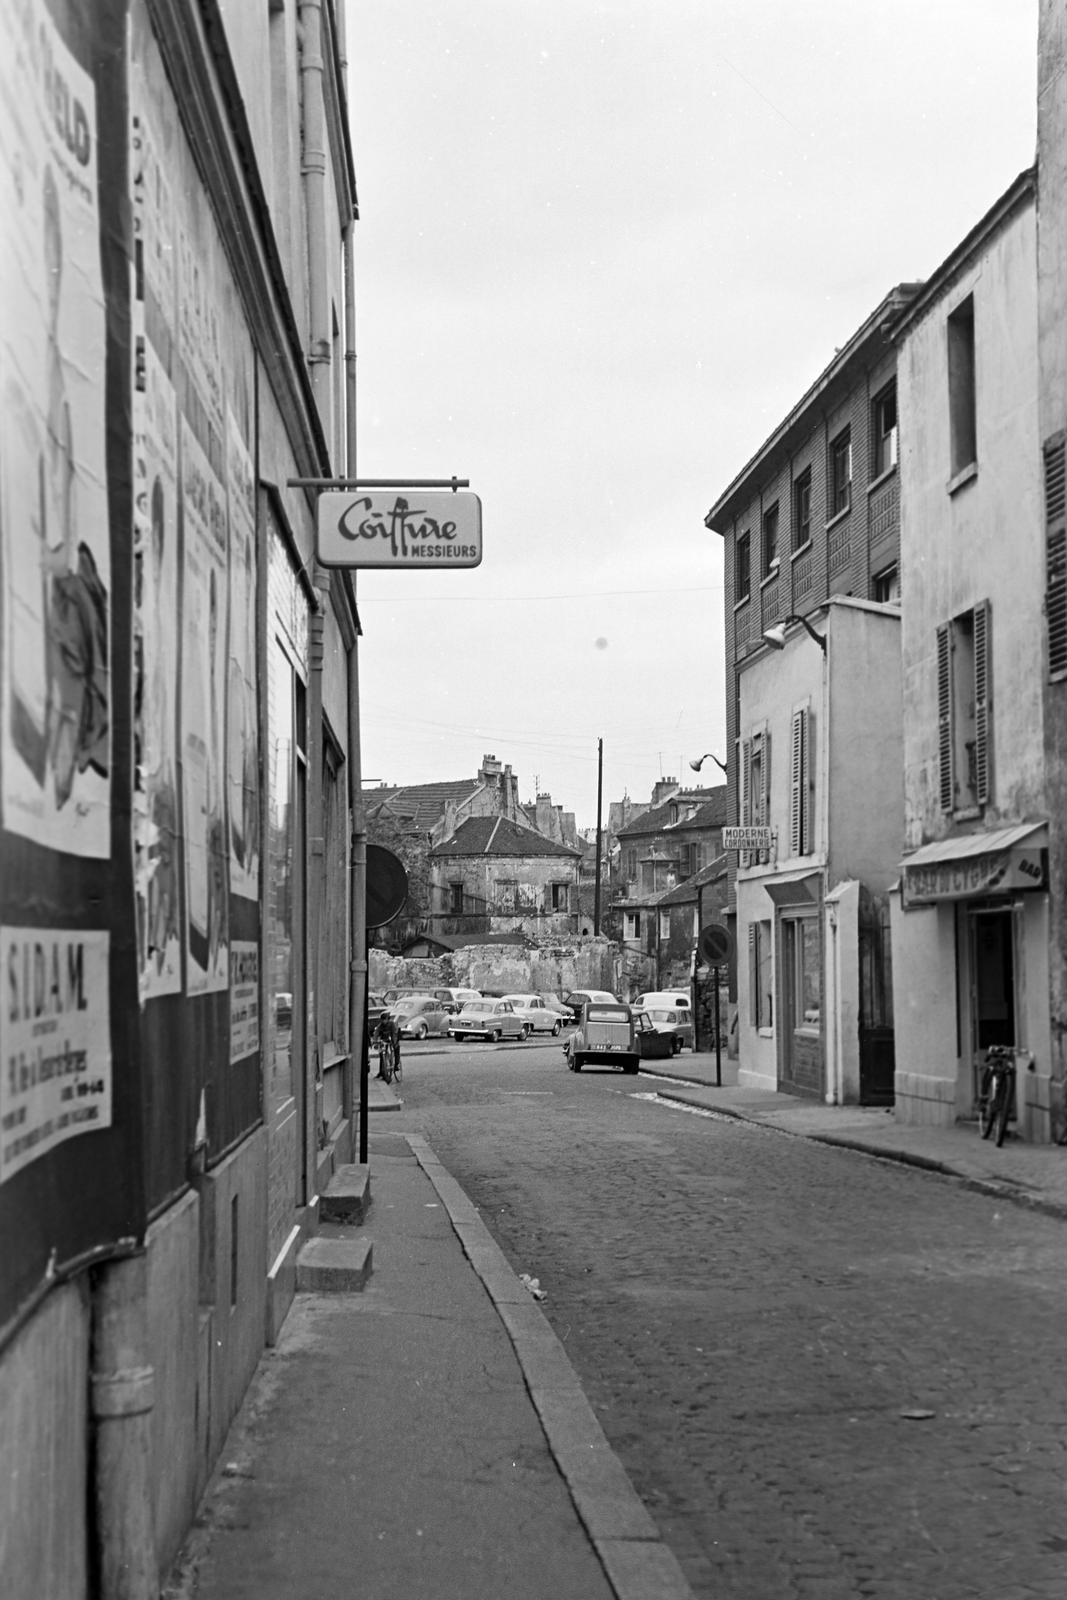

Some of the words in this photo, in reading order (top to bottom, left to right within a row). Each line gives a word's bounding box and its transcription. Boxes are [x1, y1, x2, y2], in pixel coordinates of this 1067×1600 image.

[338, 496, 457, 557] Coiffure
[411, 544, 477, 557] MESSIEURS
[725, 829, 769, 839] MODERNE
[724, 839, 770, 848] CORDONNERIE
[1018, 858, 1041, 879] BAR
